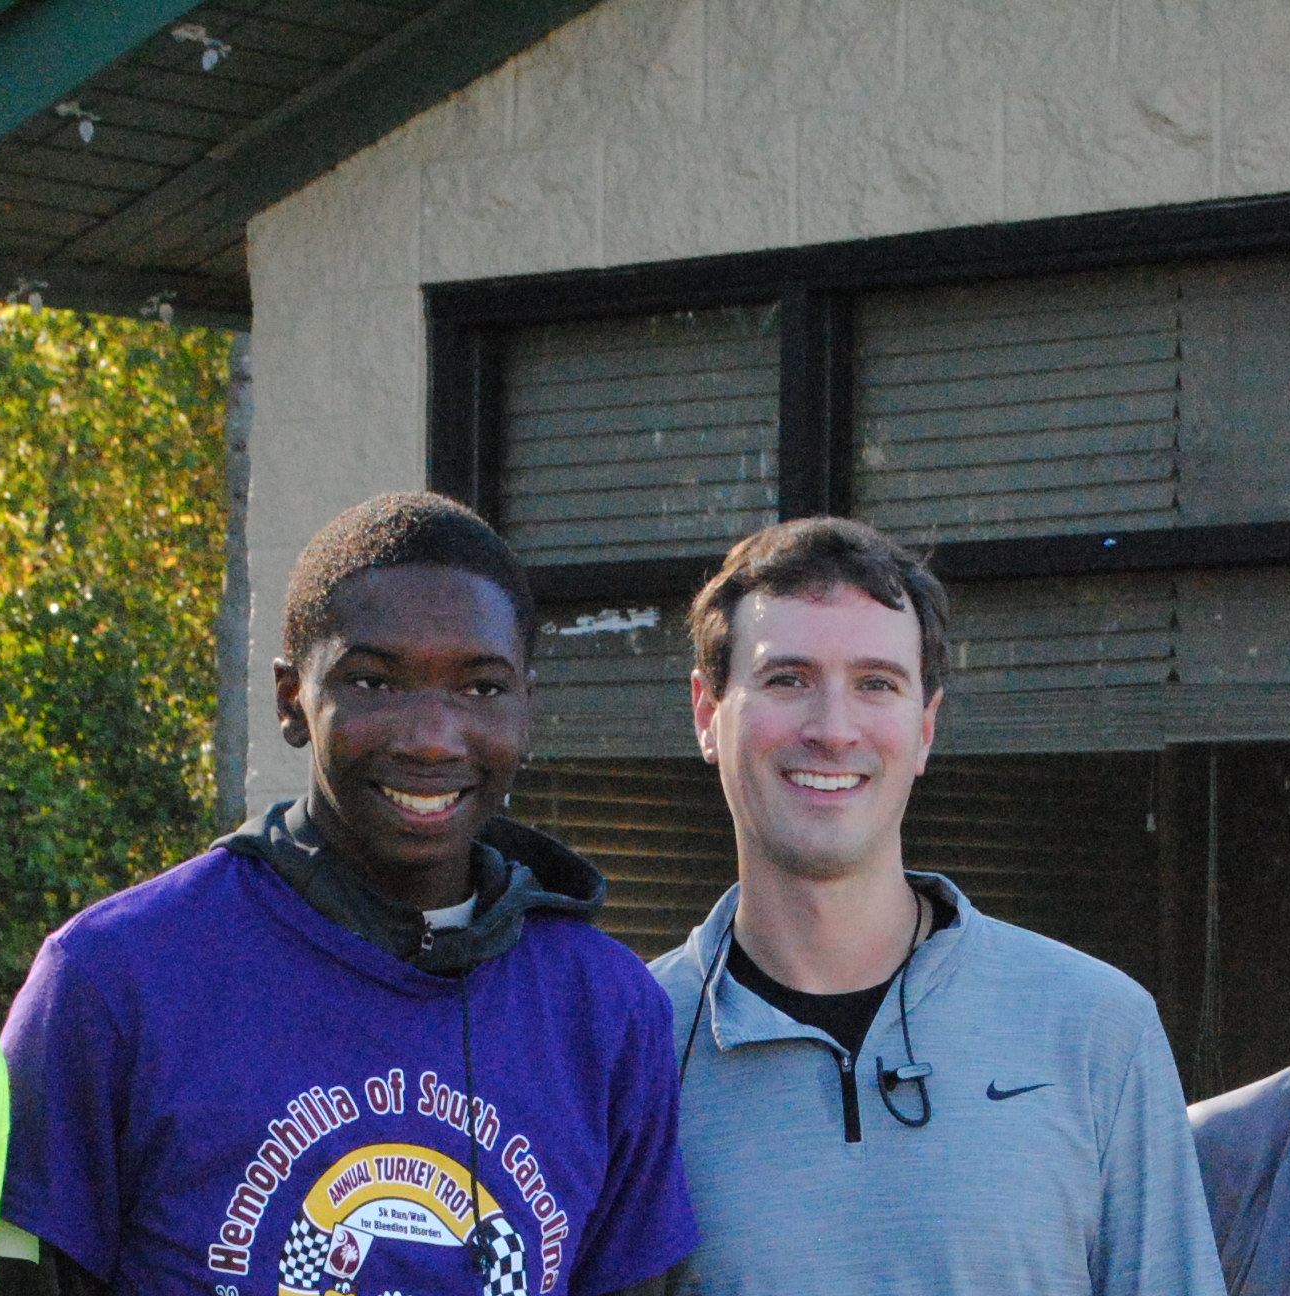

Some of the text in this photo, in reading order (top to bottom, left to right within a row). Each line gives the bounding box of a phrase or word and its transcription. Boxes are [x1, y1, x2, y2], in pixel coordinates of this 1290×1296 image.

[209, 1086, 359, 1275] Hemophilia
[418, 1071, 500, 1151] South
[501, 1134, 568, 1294] Carolina
[327, 1156, 474, 1223] ANNUAL TURKEY TROT
[374, 1220, 408, 1234] Bleeding
[410, 1223, 442, 1238] Disorders
